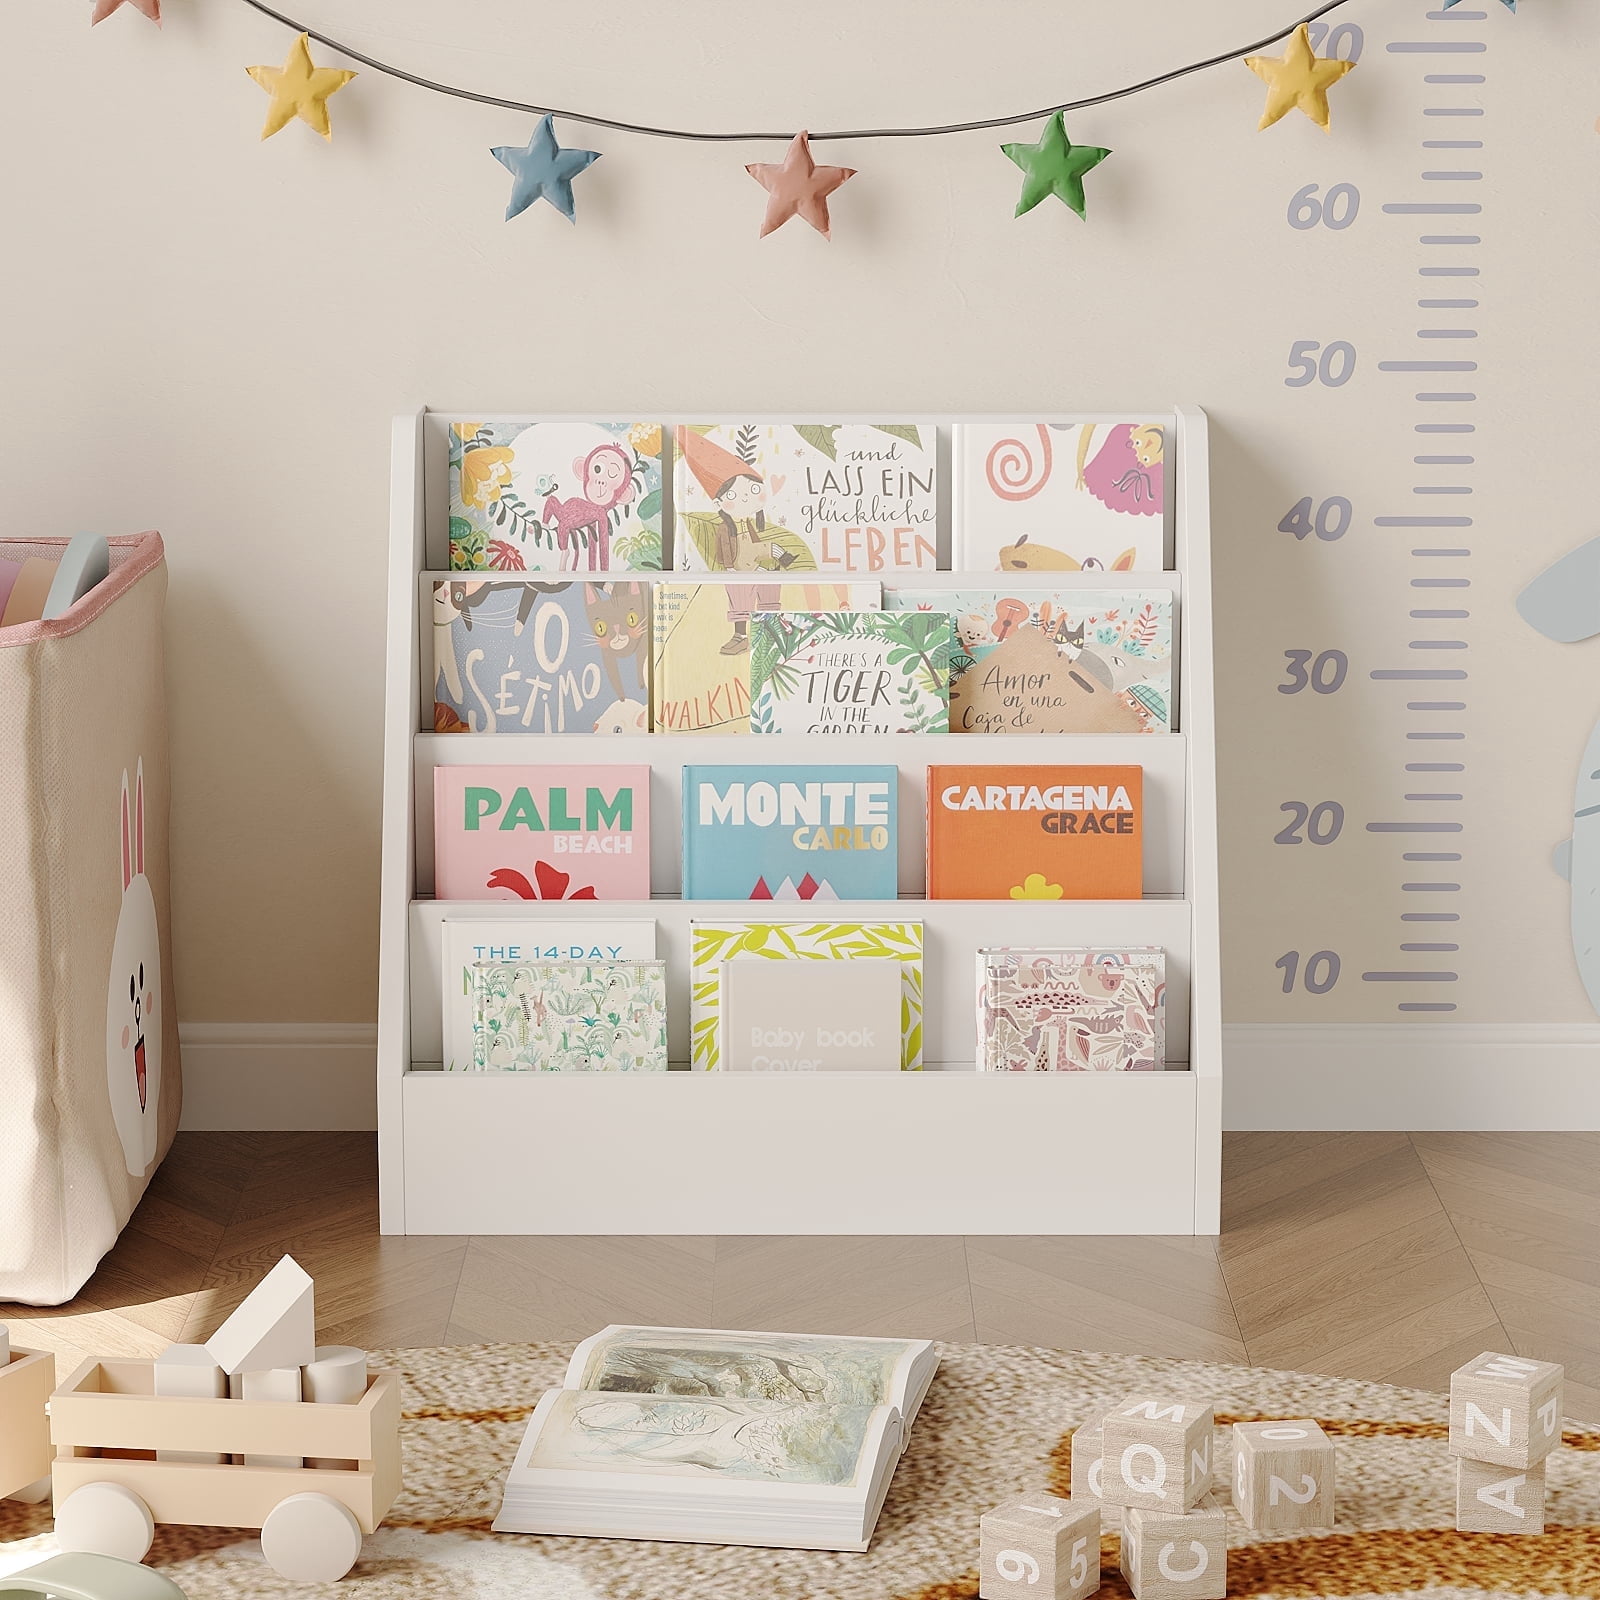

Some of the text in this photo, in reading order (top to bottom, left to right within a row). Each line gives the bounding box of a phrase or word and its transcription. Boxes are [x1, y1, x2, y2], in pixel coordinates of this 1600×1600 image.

[1286, 182, 1360, 231] 60
[1284, 340, 1357, 388] 50
[845, 443, 903, 461] und
[806, 465, 864, 496] LASS
[1277, 495, 1353, 542] 40
[533, 601, 570, 674] O
[816, 652, 882, 668] THERE'S A
[1277, 649, 1349, 695] 30
[801, 669, 892, 706] TIGER
[980, 665, 1051, 698] Amor
[820, 705, 871, 723] IN THE
[962, 705, 1035, 733] Caja de
[1003, 695, 1067, 708] en una
[464, 787, 633, 831] PALM
[699, 781, 889, 827] MONTE
[941, 785, 1133, 811] CARTAGENA
[792, 826, 889, 851] CARLO
[1041, 812, 1134, 834] GRACE
[1273, 800, 1345, 846] 20
[553, 835, 632, 854] BEACH
[473, 946, 623, 959] THE 14-DAY
[1275, 950, 1341, 995] 10
[751, 1027, 875, 1051] Baby book
[1120, 1443, 1167, 1499] Q
[1269, 1474, 1317, 1506] 2
[1476, 1473, 1527, 1519] A
[1069, 1536, 1088, 1589] 5
[1157, 1540, 1209, 1582] C
